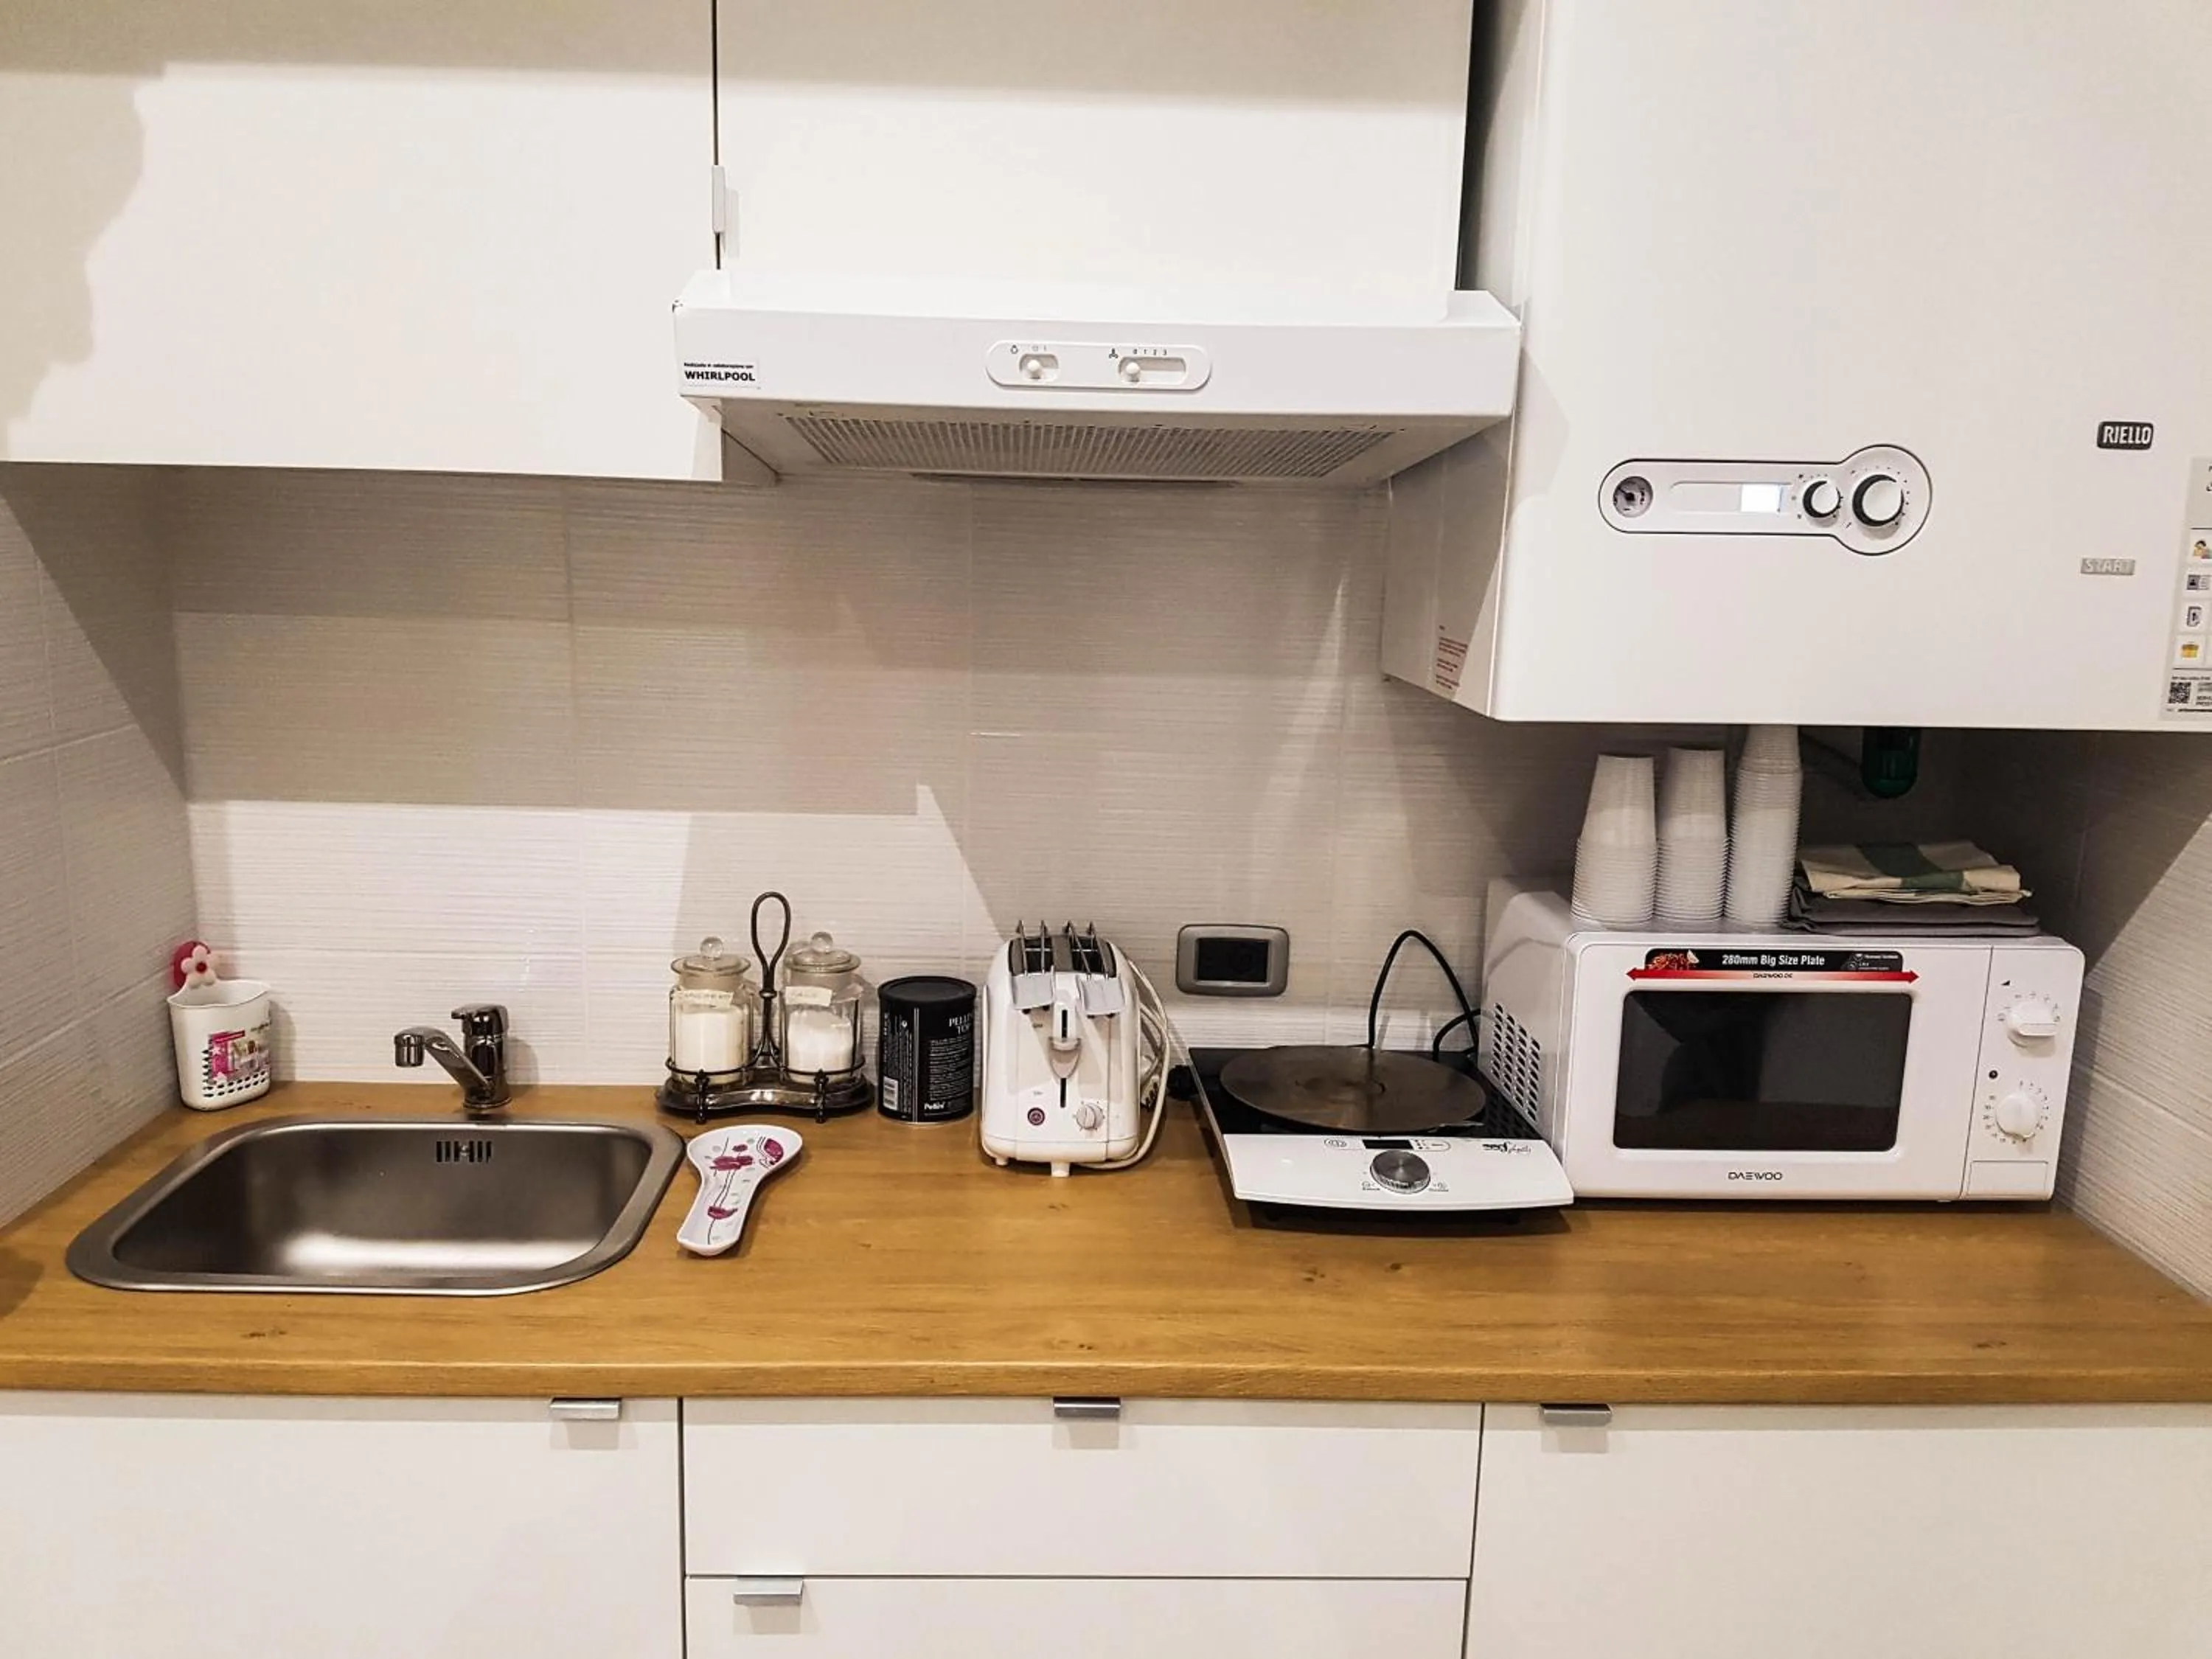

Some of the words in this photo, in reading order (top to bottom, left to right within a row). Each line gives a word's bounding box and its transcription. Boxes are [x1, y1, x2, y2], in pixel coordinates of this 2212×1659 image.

[684, 370, 756, 381] WHIRLPOOL
[2102, 425, 2152, 445] RIELLO
[2084, 559, 2132, 574] START
[1722, 953, 1759, 965] 280mm
[1760, 954, 1776, 967] Big
[1778, 954, 1798, 965] Size
[1800, 955, 1826, 966] Plate
[1727, 1171, 1784, 1180] DAEWOO
